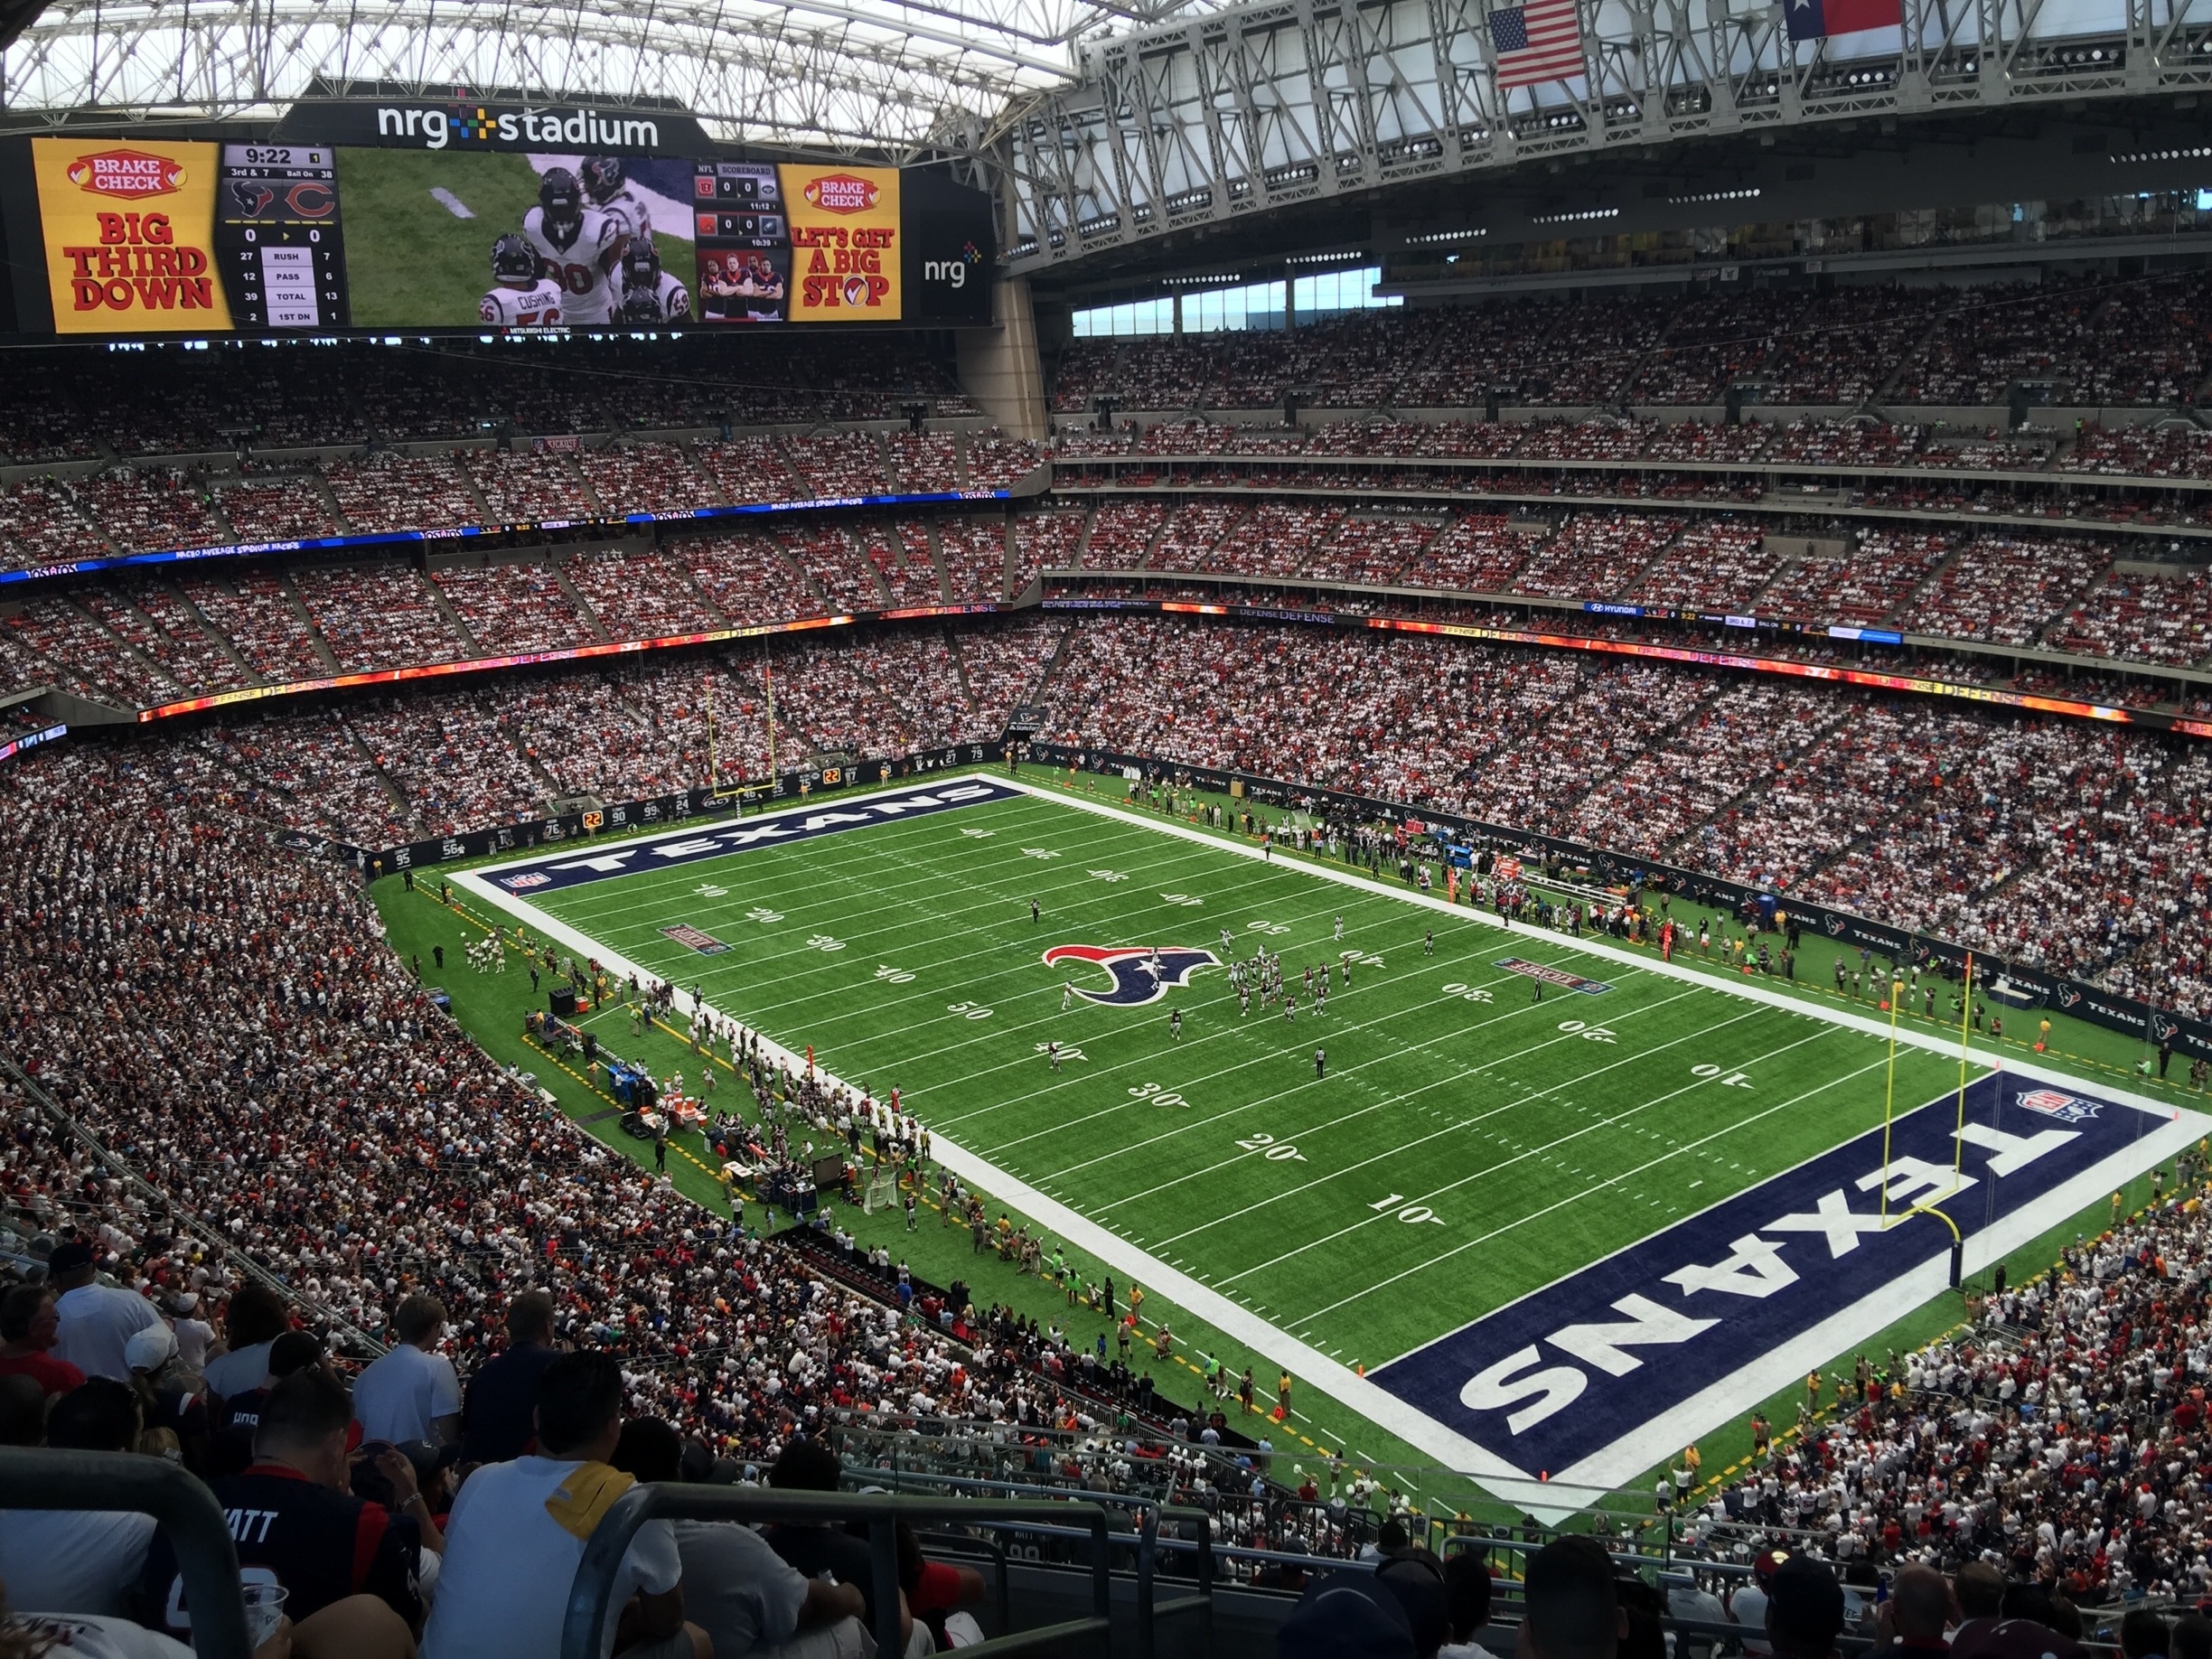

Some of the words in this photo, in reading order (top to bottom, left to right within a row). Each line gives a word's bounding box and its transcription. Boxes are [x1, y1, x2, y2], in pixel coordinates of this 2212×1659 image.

[378, 108, 448, 149] nrg
[499, 108, 659, 146] stadium
[246, 148, 292, 164] 9:22
[93, 160, 160, 173] BRAKE
[230, 168, 248, 176] 3rd
[263, 168, 269, 177] 7
[722, 166, 770, 174] SCOREBOARD
[303, 170, 314, 178] On
[321, 171, 333, 179] 38
[95, 175, 162, 190] CHECK
[724, 182, 730, 192] 0
[745, 183, 752, 192] 0
[821, 182, 865, 194] BRAKE
[821, 194, 864, 208] CHECK
[97, 212, 173, 245] BIG
[726, 220, 732, 229] 0
[745, 220, 753, 230] 0
[245, 229, 256, 242] 0
[309, 230, 320, 242] 0
[792, 227, 848, 248] LET'S
[851, 228, 895, 248] GET
[63, 246, 207, 277] THIRD
[240, 252, 253, 260] 27
[274, 253, 299, 261] RUSH
[323, 252, 331, 261] 7
[808, 249, 830, 274] A
[833, 249, 881, 274] BIG
[243, 272, 256, 281] 12
[276, 273, 300, 281] PASS
[325, 272, 333, 281] 6
[924, 260, 966, 288] nrg
[71, 277, 213, 311] DOWN
[245, 292, 258, 301] 39
[276, 293, 306, 301] TOTAL
[324, 292, 337, 301] 13
[517, 291, 556, 309] CUSHING
[249, 313, 257, 321] 2
[278, 313, 295, 322] 1ST
[297, 313, 311, 322] DN
[543, 326, 571, 334] ELECTRIC
[1240, 608, 1279, 619] DEFENSE
[1279, 611, 1336, 623] DEFENSE
[1604, 605, 1636, 614] HYUNDAI
[1943, 684, 2026, 707] DEFENSE
[945, 754, 957, 764] 27
[970, 749, 984, 759] 79
[825, 770, 839, 783] 22
[1250, 785, 1282, 797] TEXANS
[643, 806, 657, 817] 99
[675, 800, 689, 811] 24
[586, 813, 601, 826] 22
[612, 811, 625, 823] 90
[546, 784, 994, 872] TEXANS
[442, 843, 458, 856] 56
[396, 852, 410, 866] 95
[1552, 849, 1592, 865] TEXANS
[694, 884, 728, 897] 10
[745, 906, 784, 923] 20
[806, 935, 847, 951] 30
[1853, 929, 1902, 950] TEXANS
[874, 967, 916, 984] 40
[1998, 972, 2051, 995] TEXANS
[947, 1000, 993, 1019] 50
[2087, 1000, 2146, 1026] TEXANS
[1557, 1020, 1616, 1042] 20
[1127, 1083, 1183, 1107] 30
[1234, 1132, 1298, 1161] 20
[1366, 1193, 1433, 1223] 10
[1459, 1122, 2083, 1436] TEXANS
